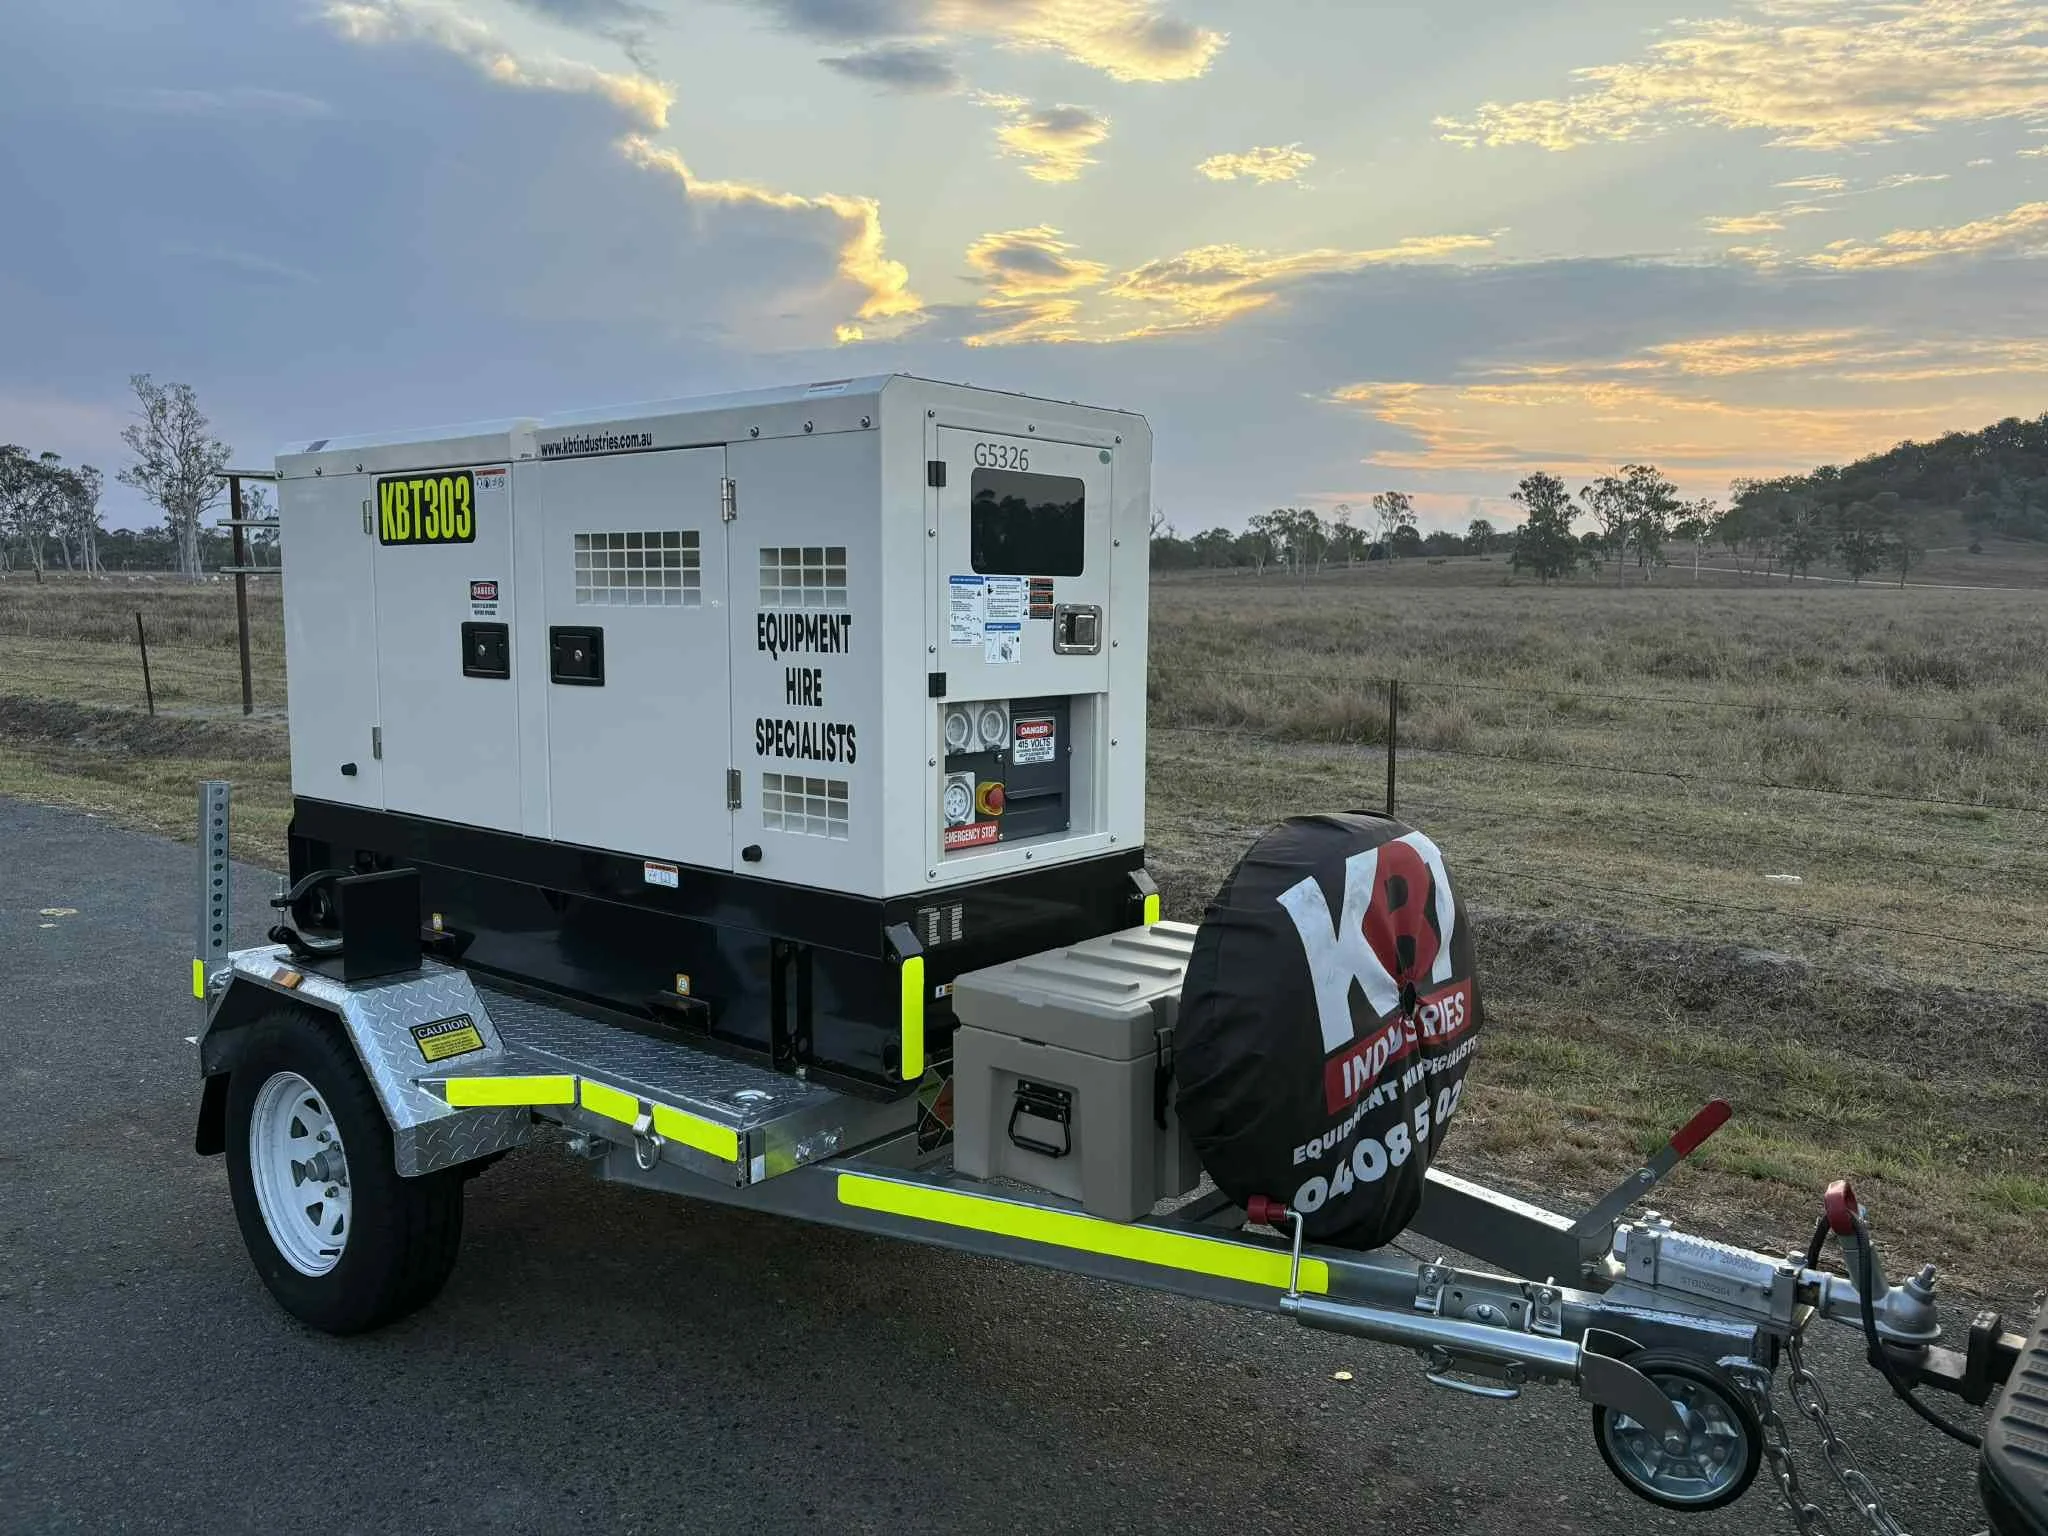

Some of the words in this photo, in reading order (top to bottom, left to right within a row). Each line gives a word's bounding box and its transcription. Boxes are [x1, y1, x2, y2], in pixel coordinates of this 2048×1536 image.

[540, 431, 653, 457] www.kbtindustries.com.au
[974, 442, 1029, 471] G5326
[380, 475, 471, 541] KBT303
[757, 613, 851, 661] EQUIPMENT
[785, 667, 823, 707] HIRE
[755, 717, 857, 765] SPECIALISTS
[1018, 740, 1028, 749] 415
[1031, 738, 1051, 748] VOLTS
[1021, 725, 1048, 735] DANGER
[944, 828, 980, 844] EMERGENCY
[982, 826, 997, 839] STOP
[417, 1018, 469, 1038] CAUTION
